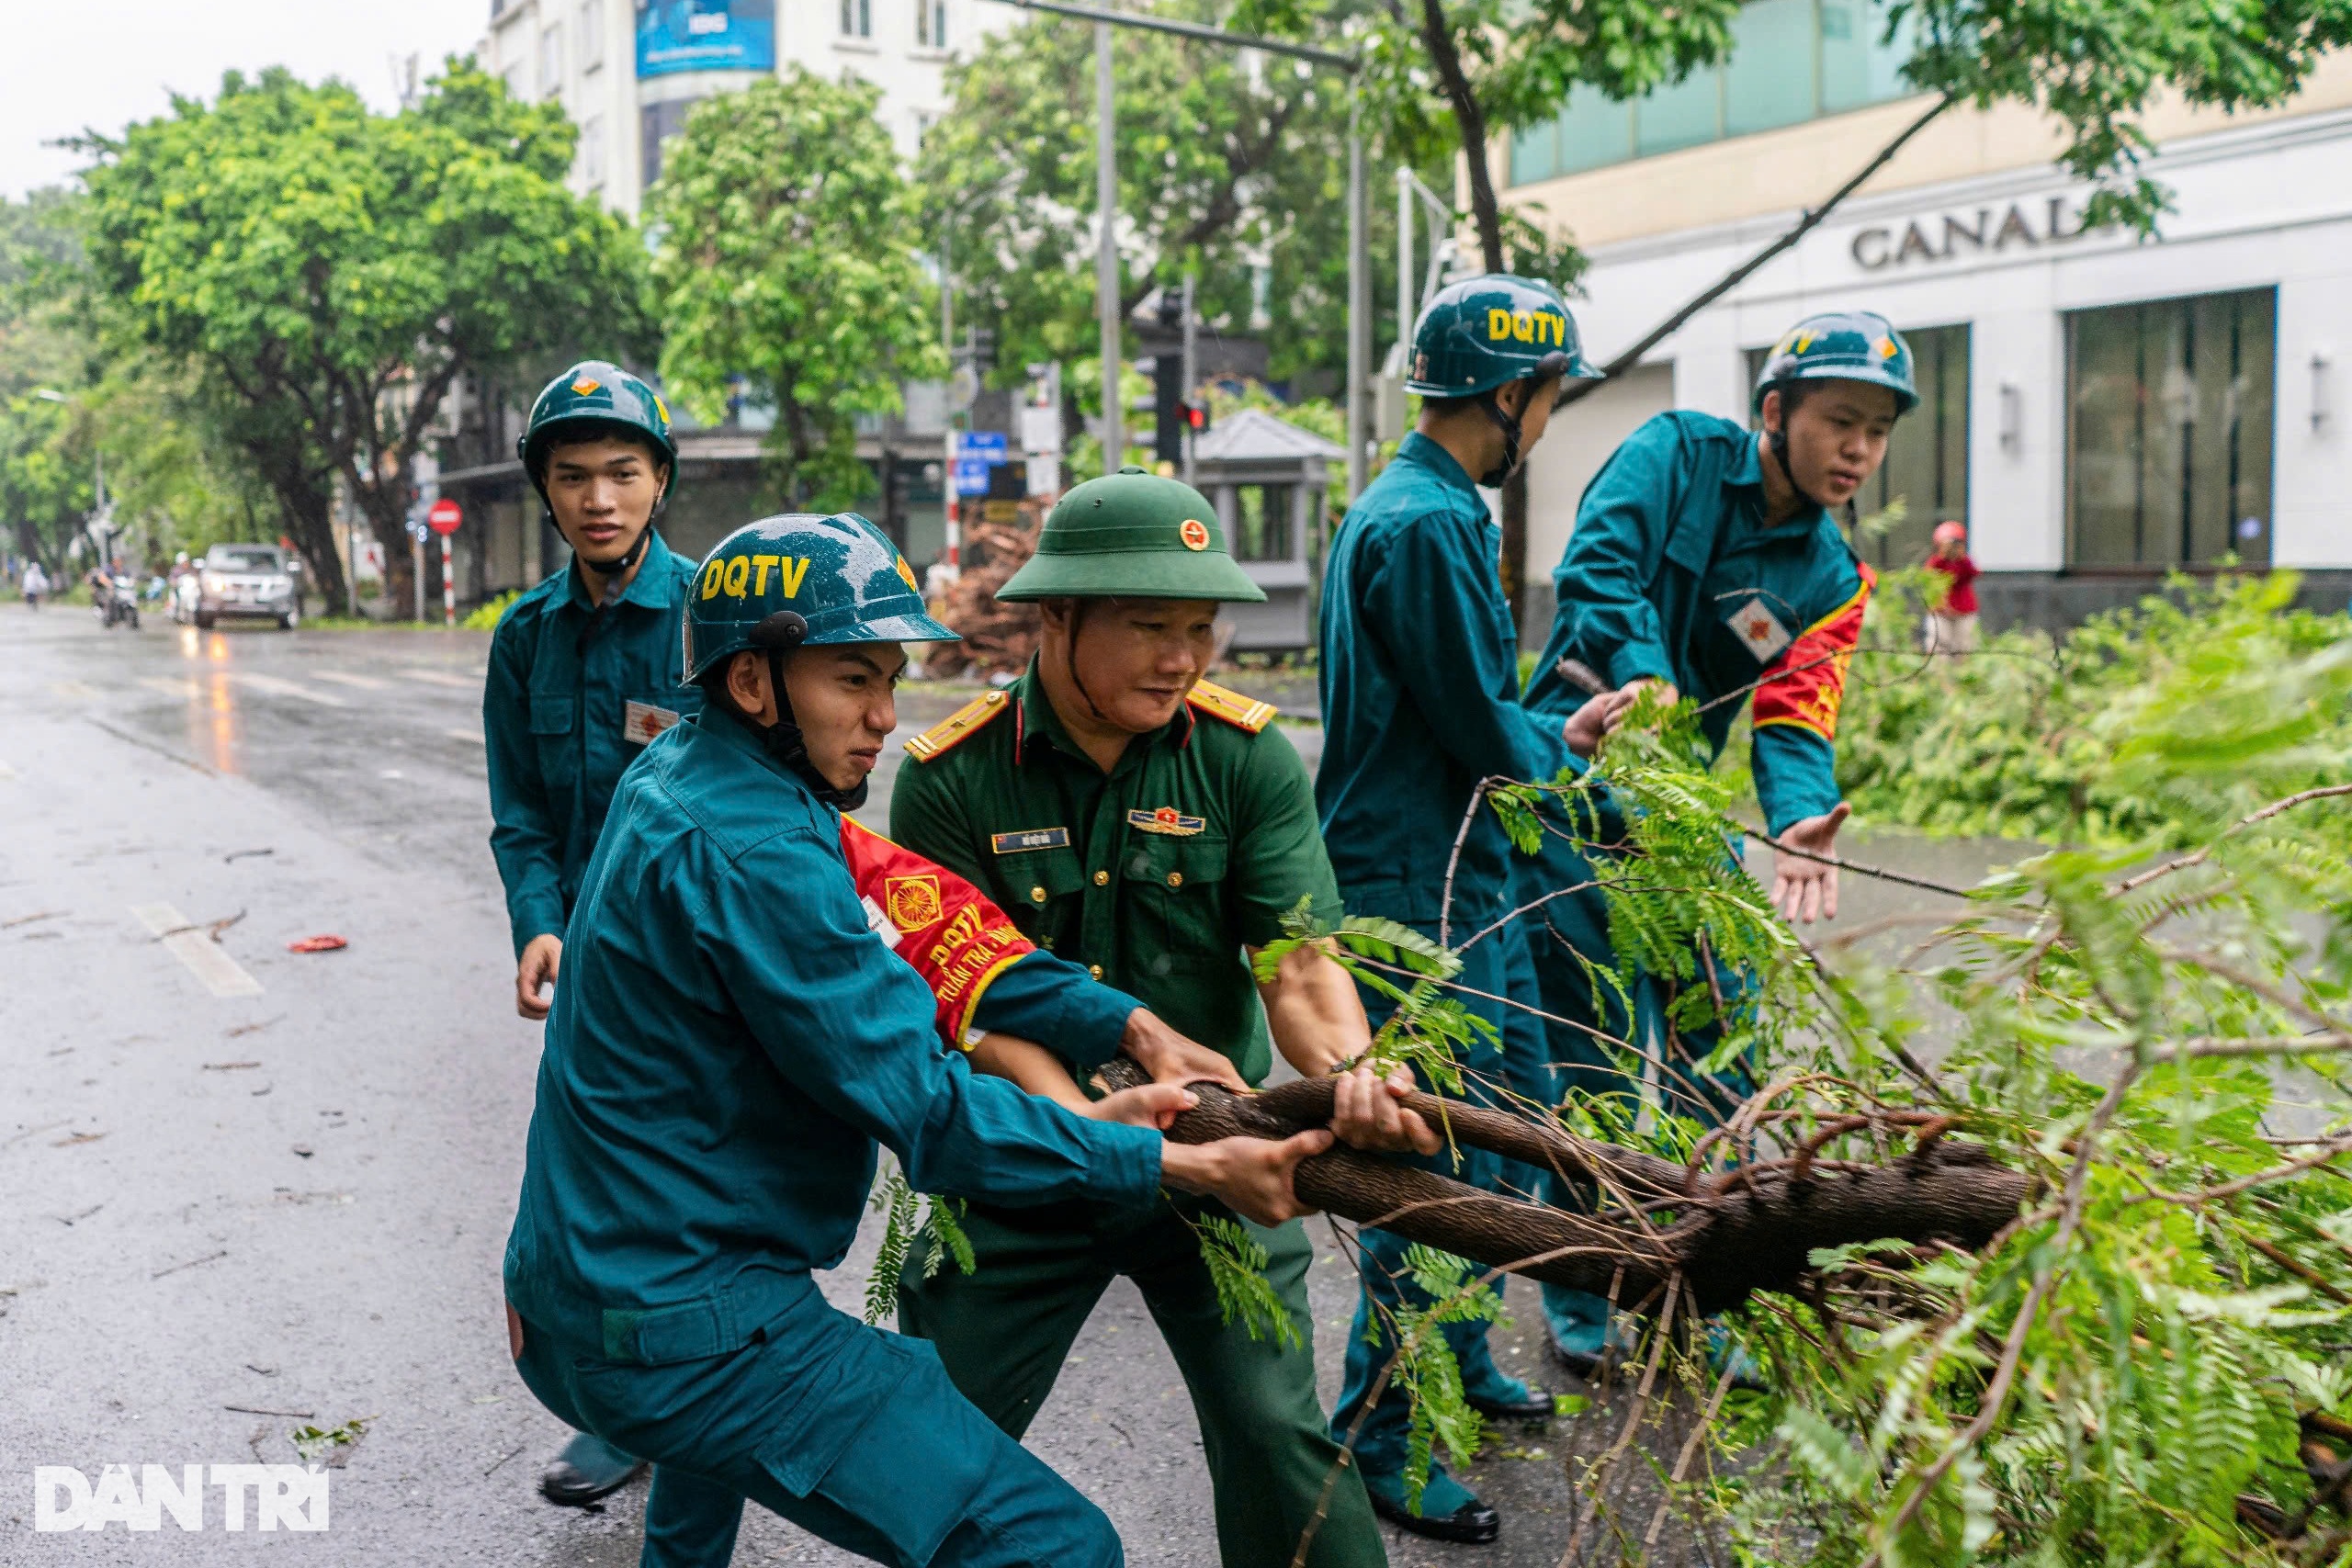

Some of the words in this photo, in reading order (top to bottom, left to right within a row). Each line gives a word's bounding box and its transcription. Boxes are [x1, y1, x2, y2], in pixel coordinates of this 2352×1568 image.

[1850, 197, 2118, 269] CANAL
[1488, 309, 1565, 347] DQTV
[702, 555, 810, 600] DQTV
[929, 903, 984, 966] DQTV
[961, 942, 997, 969] TRA
